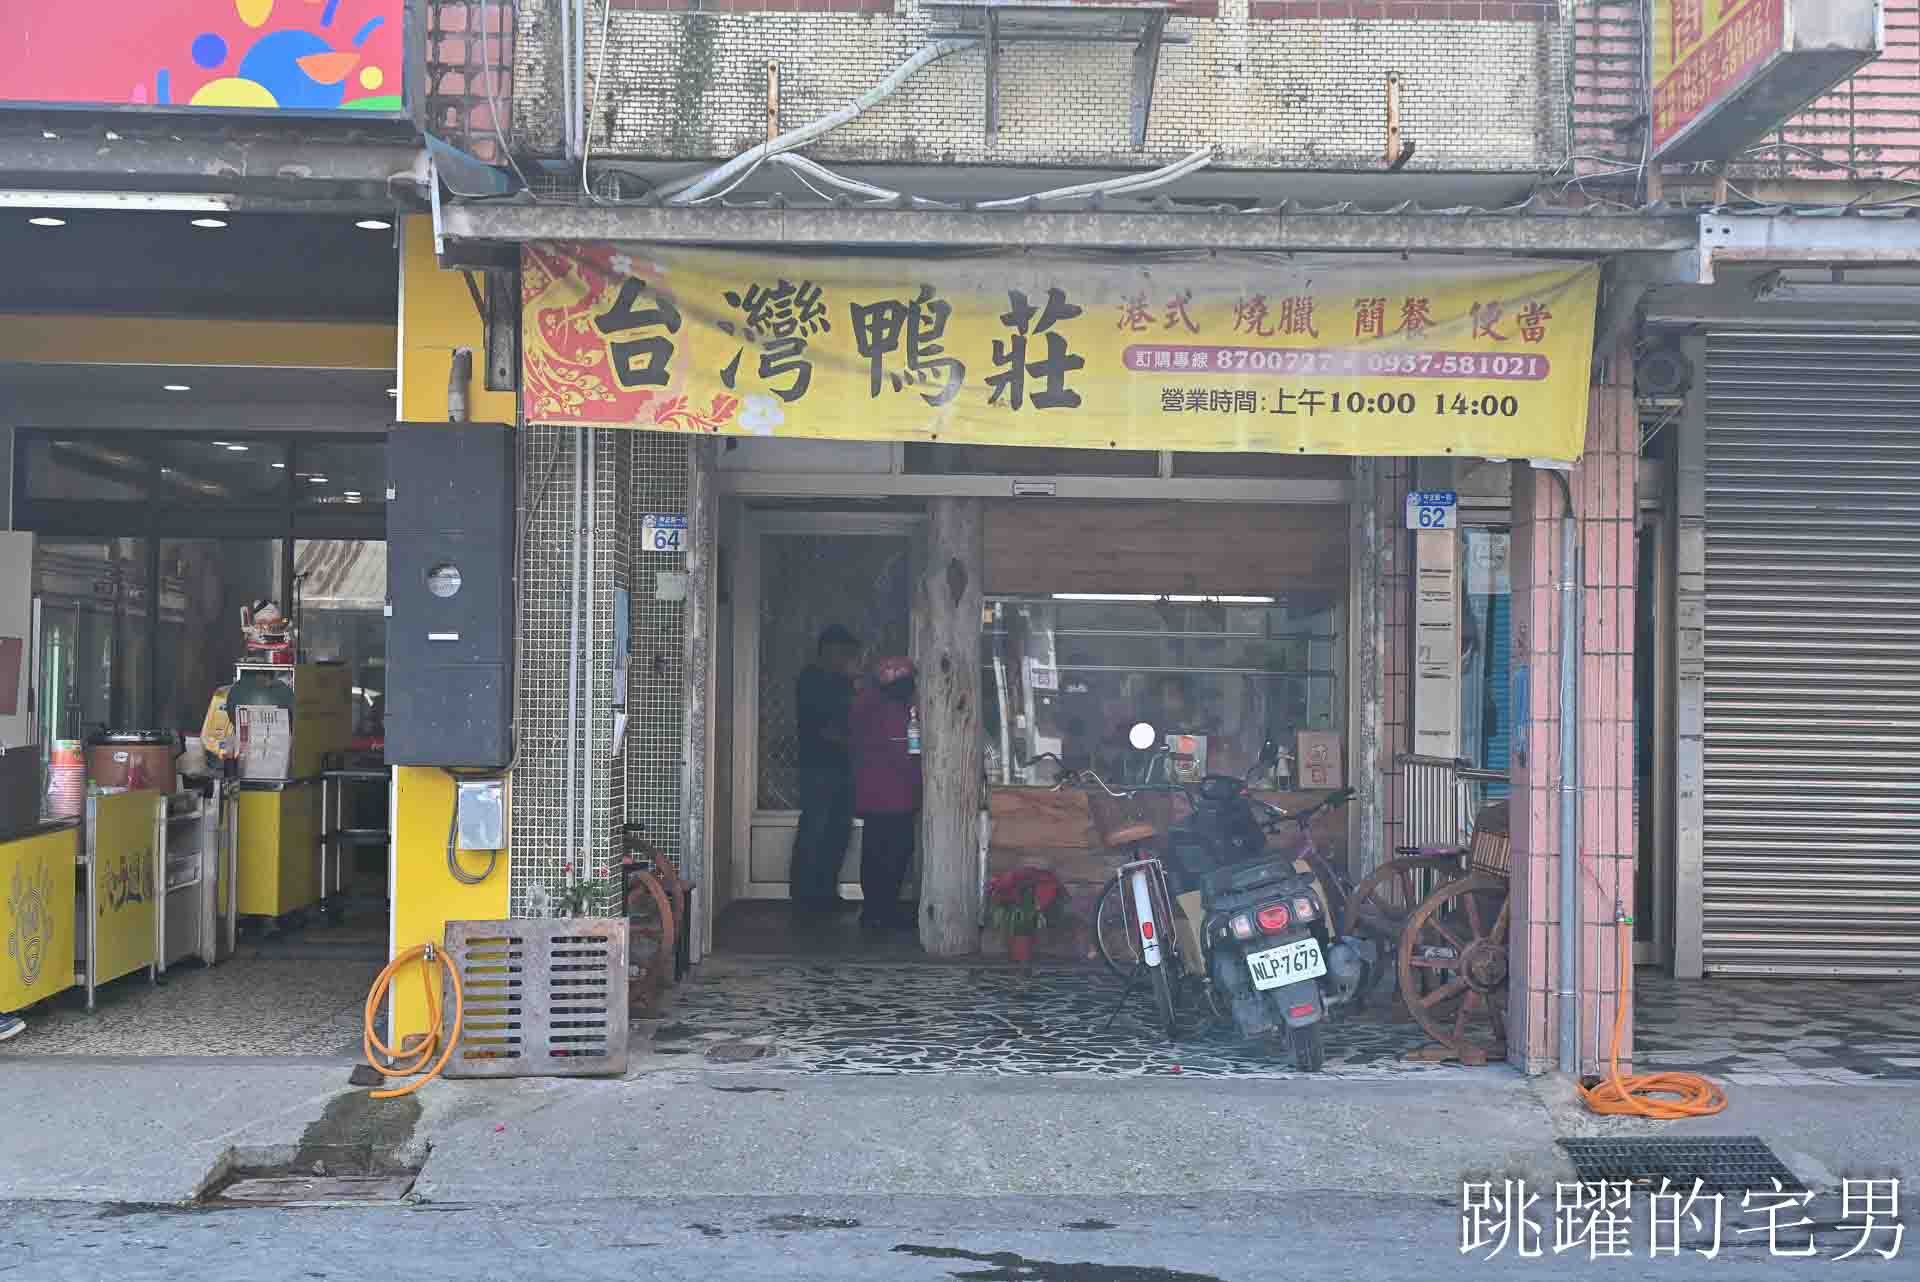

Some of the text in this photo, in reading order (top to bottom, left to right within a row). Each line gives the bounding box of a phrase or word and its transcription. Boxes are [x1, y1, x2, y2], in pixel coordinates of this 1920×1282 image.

[1117, 291, 1552, 343] 港式 燒臘 簡餐 便當
[594, 276, 1086, 410] 台灣鴨莊
[1135, 350, 1538, 376] 訂購專線 8700727 0937-581021
[1434, 391, 1519, 417] 14:00
[1419, 507, 1445, 527] 62
[655, 529, 681, 550] 64
